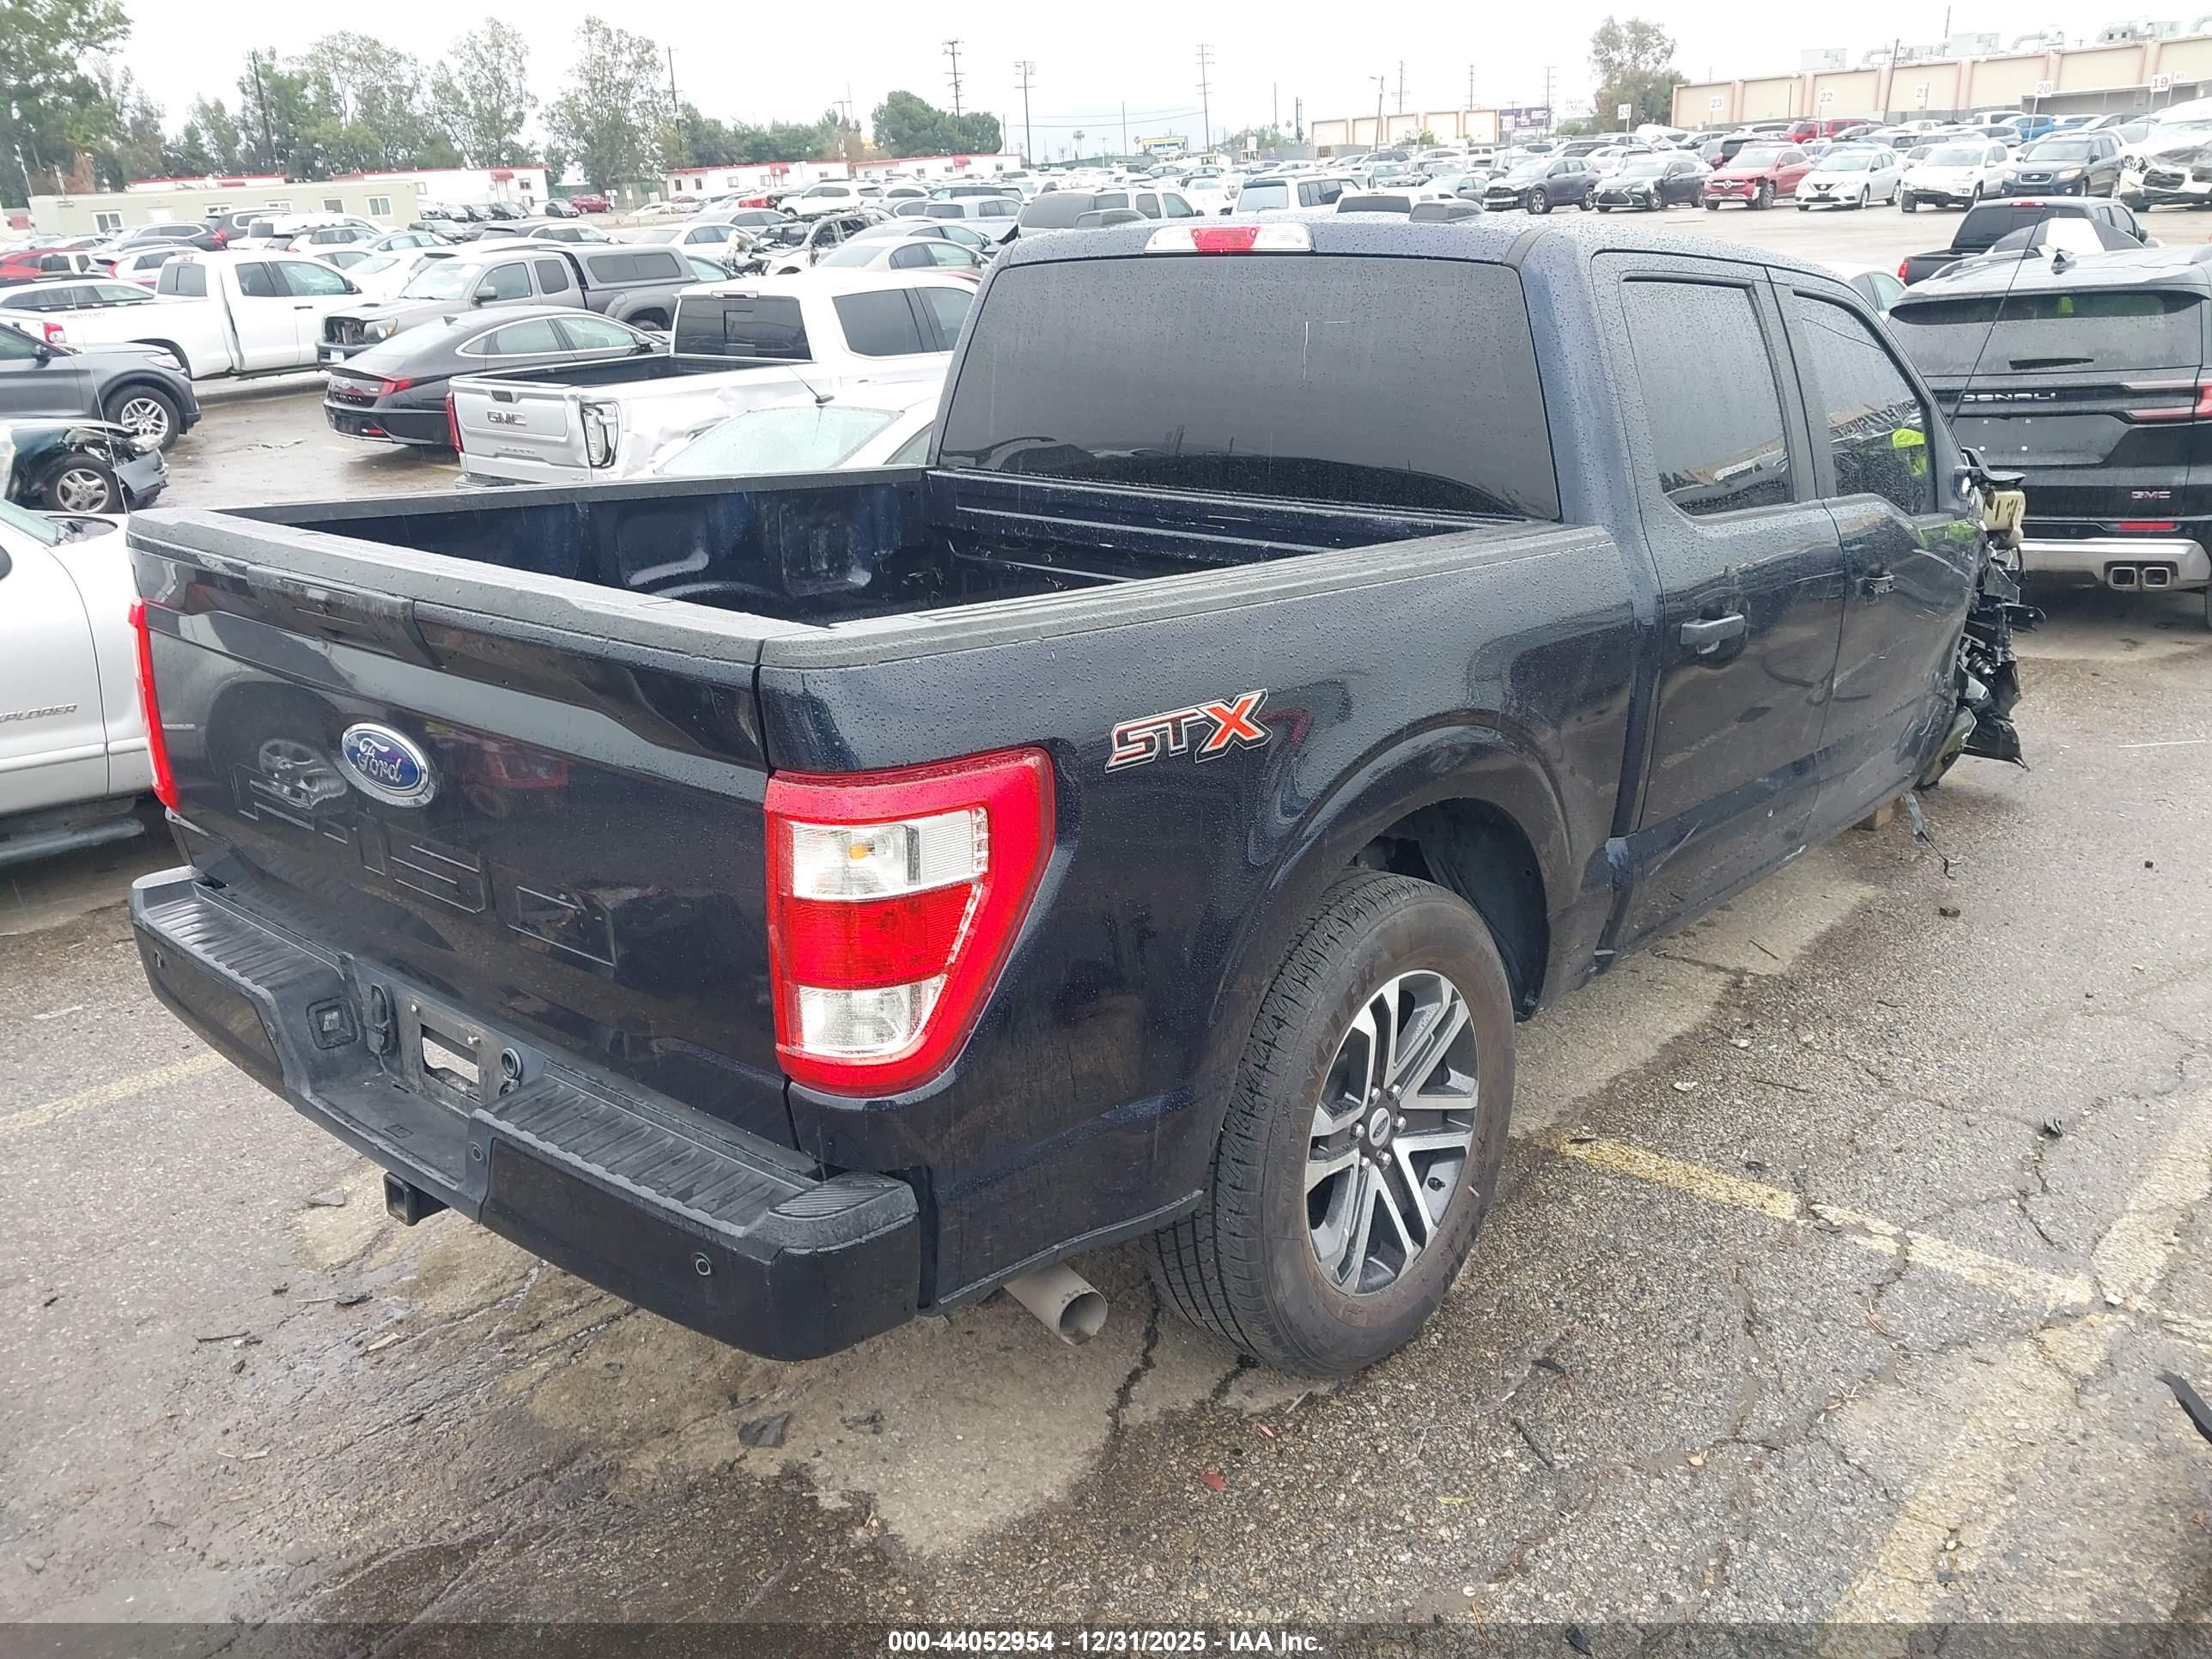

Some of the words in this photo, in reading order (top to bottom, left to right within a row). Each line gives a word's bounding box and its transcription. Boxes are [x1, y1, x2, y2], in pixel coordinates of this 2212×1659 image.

[2153, 76, 2168, 88] 19
[1917, 88, 1929, 98] 21
[2036, 83, 2051, 94] 20
[1820, 92, 1833, 102] 22
[1711, 98, 1723, 108] 23
[1619, 106, 1630, 117] 24
[1961, 392, 2057, 402] DENALI
[487, 410, 527, 427] GMC
[2131, 490, 2172, 500] GMC
[1106, 688, 1273, 774] STX
[356, 737, 403, 783] Ford
